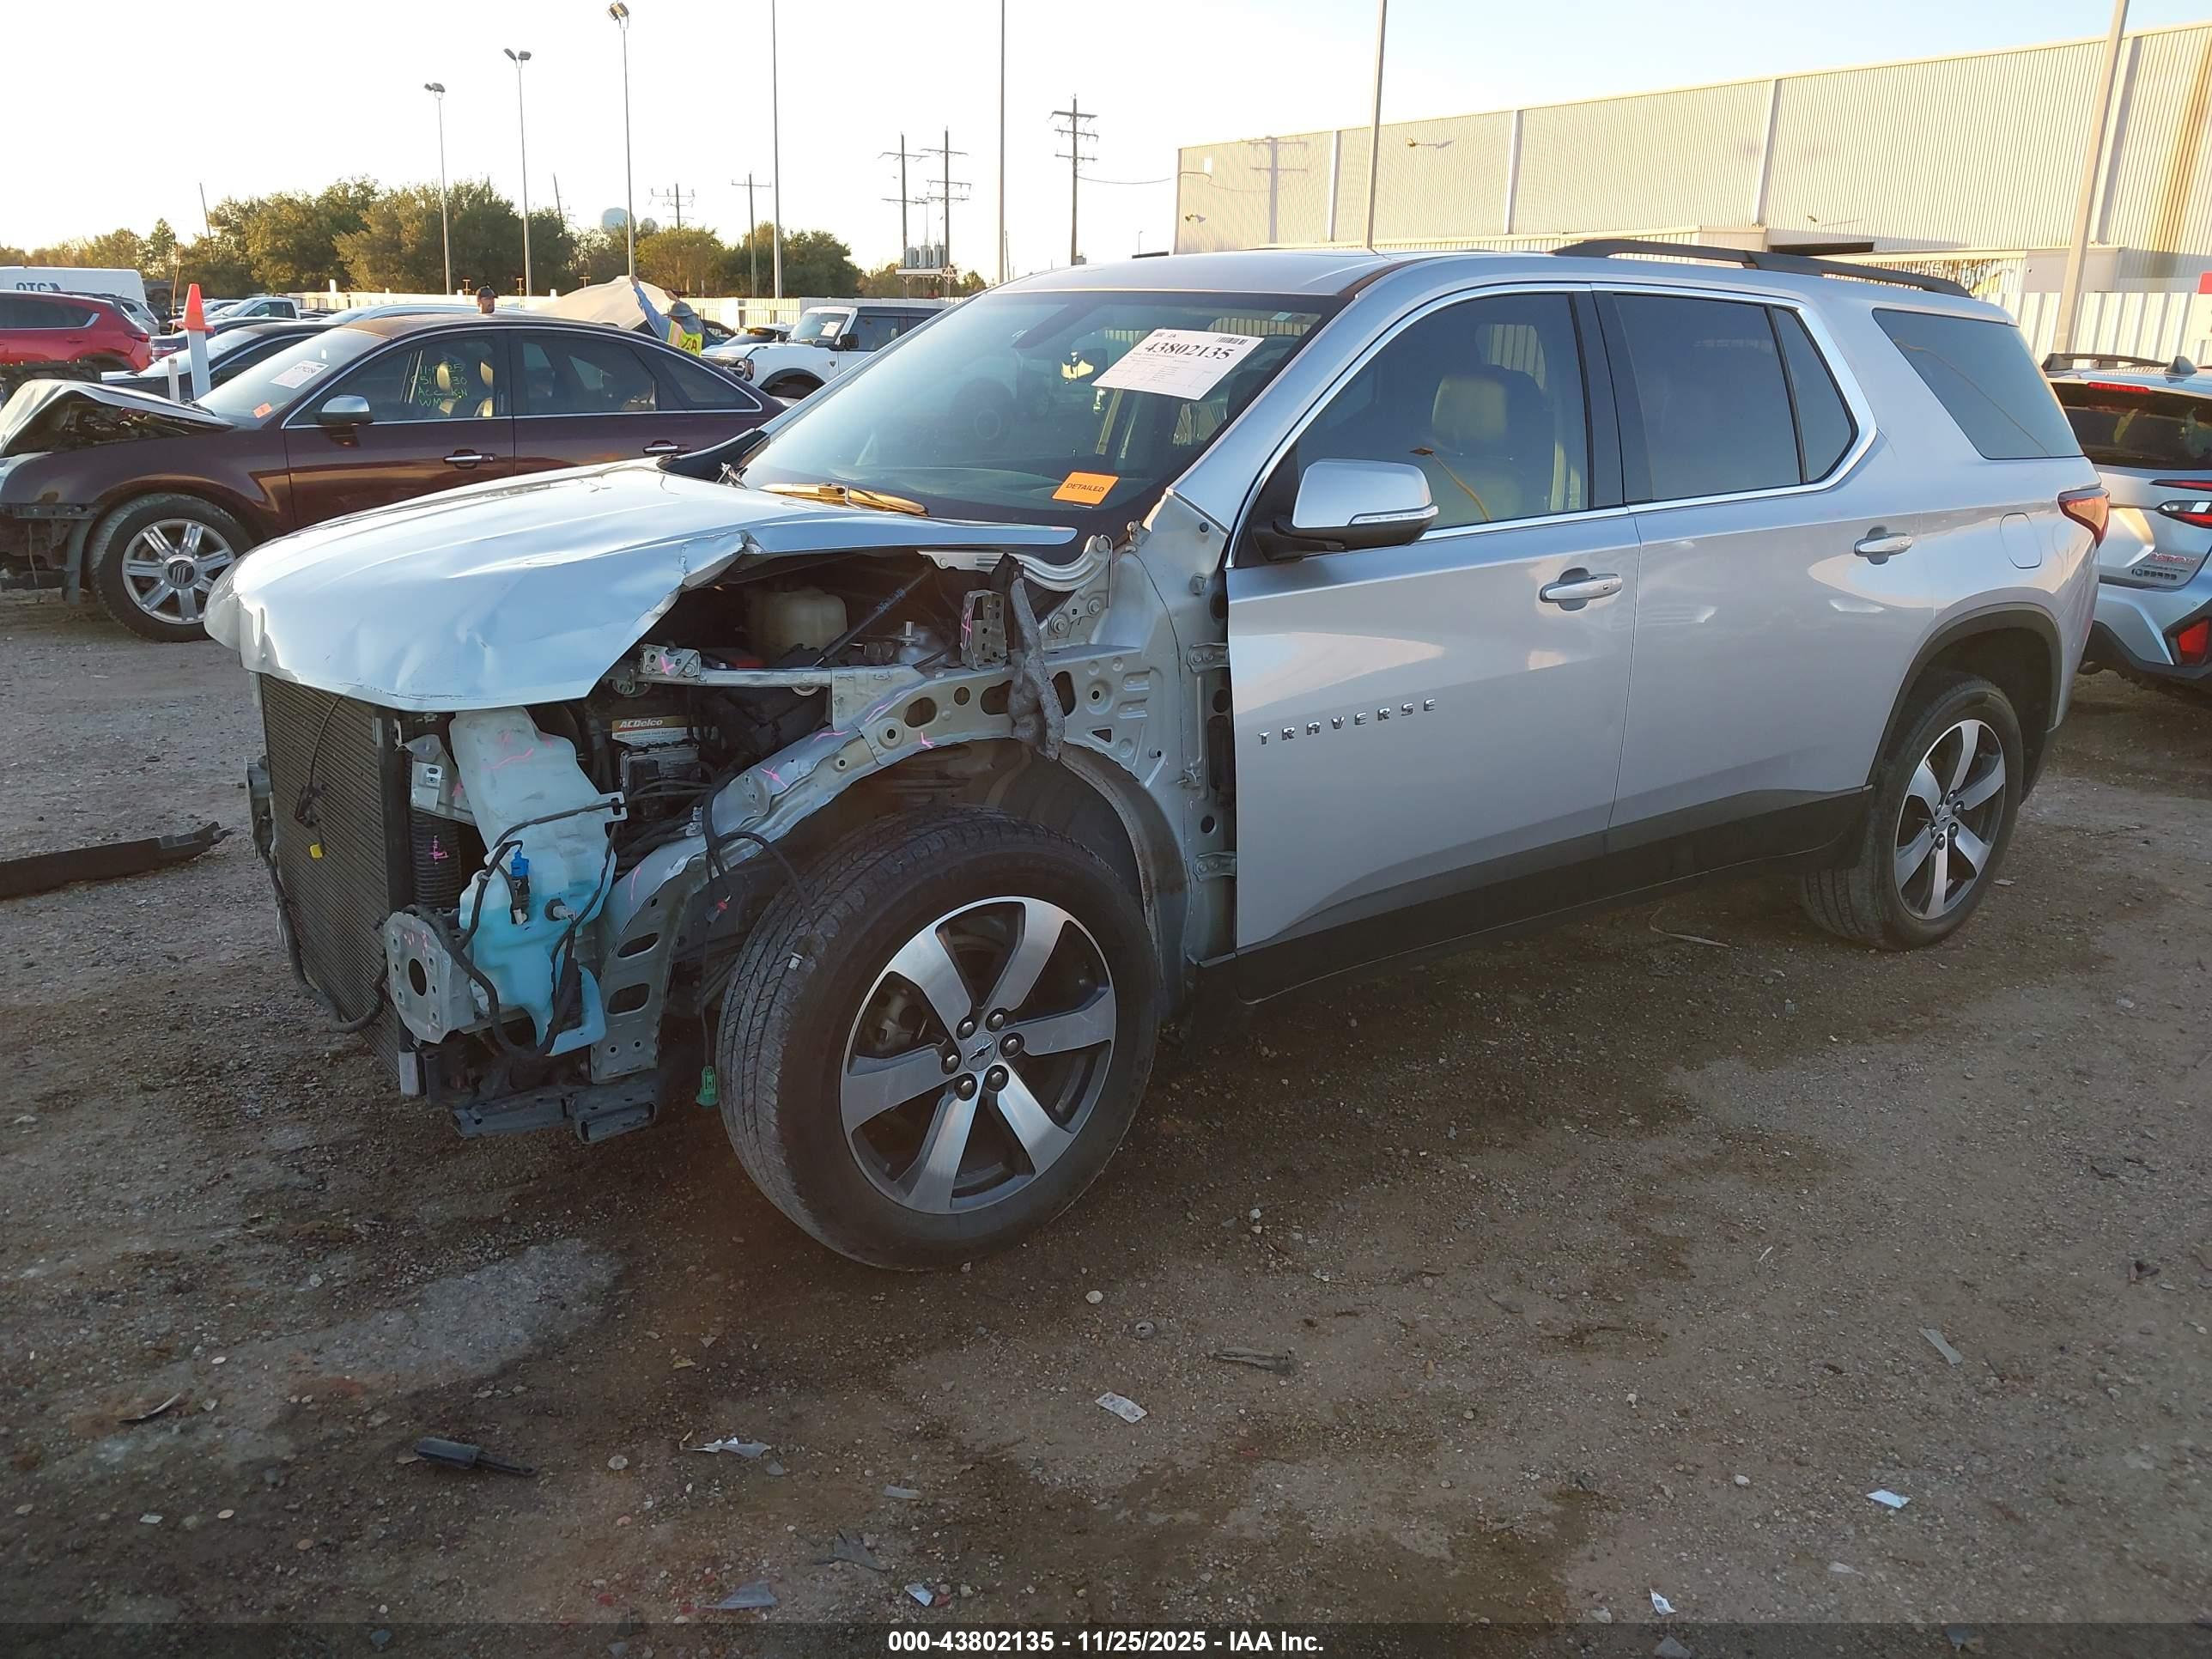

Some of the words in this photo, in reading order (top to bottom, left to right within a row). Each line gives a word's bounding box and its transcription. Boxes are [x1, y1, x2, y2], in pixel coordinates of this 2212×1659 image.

[1144, 341, 1237, 361] 43802135
[1066, 483, 1105, 493] DETAILED
[618, 719, 663, 729] ACDelco
[1257, 697, 1437, 745] TRAVERSE
